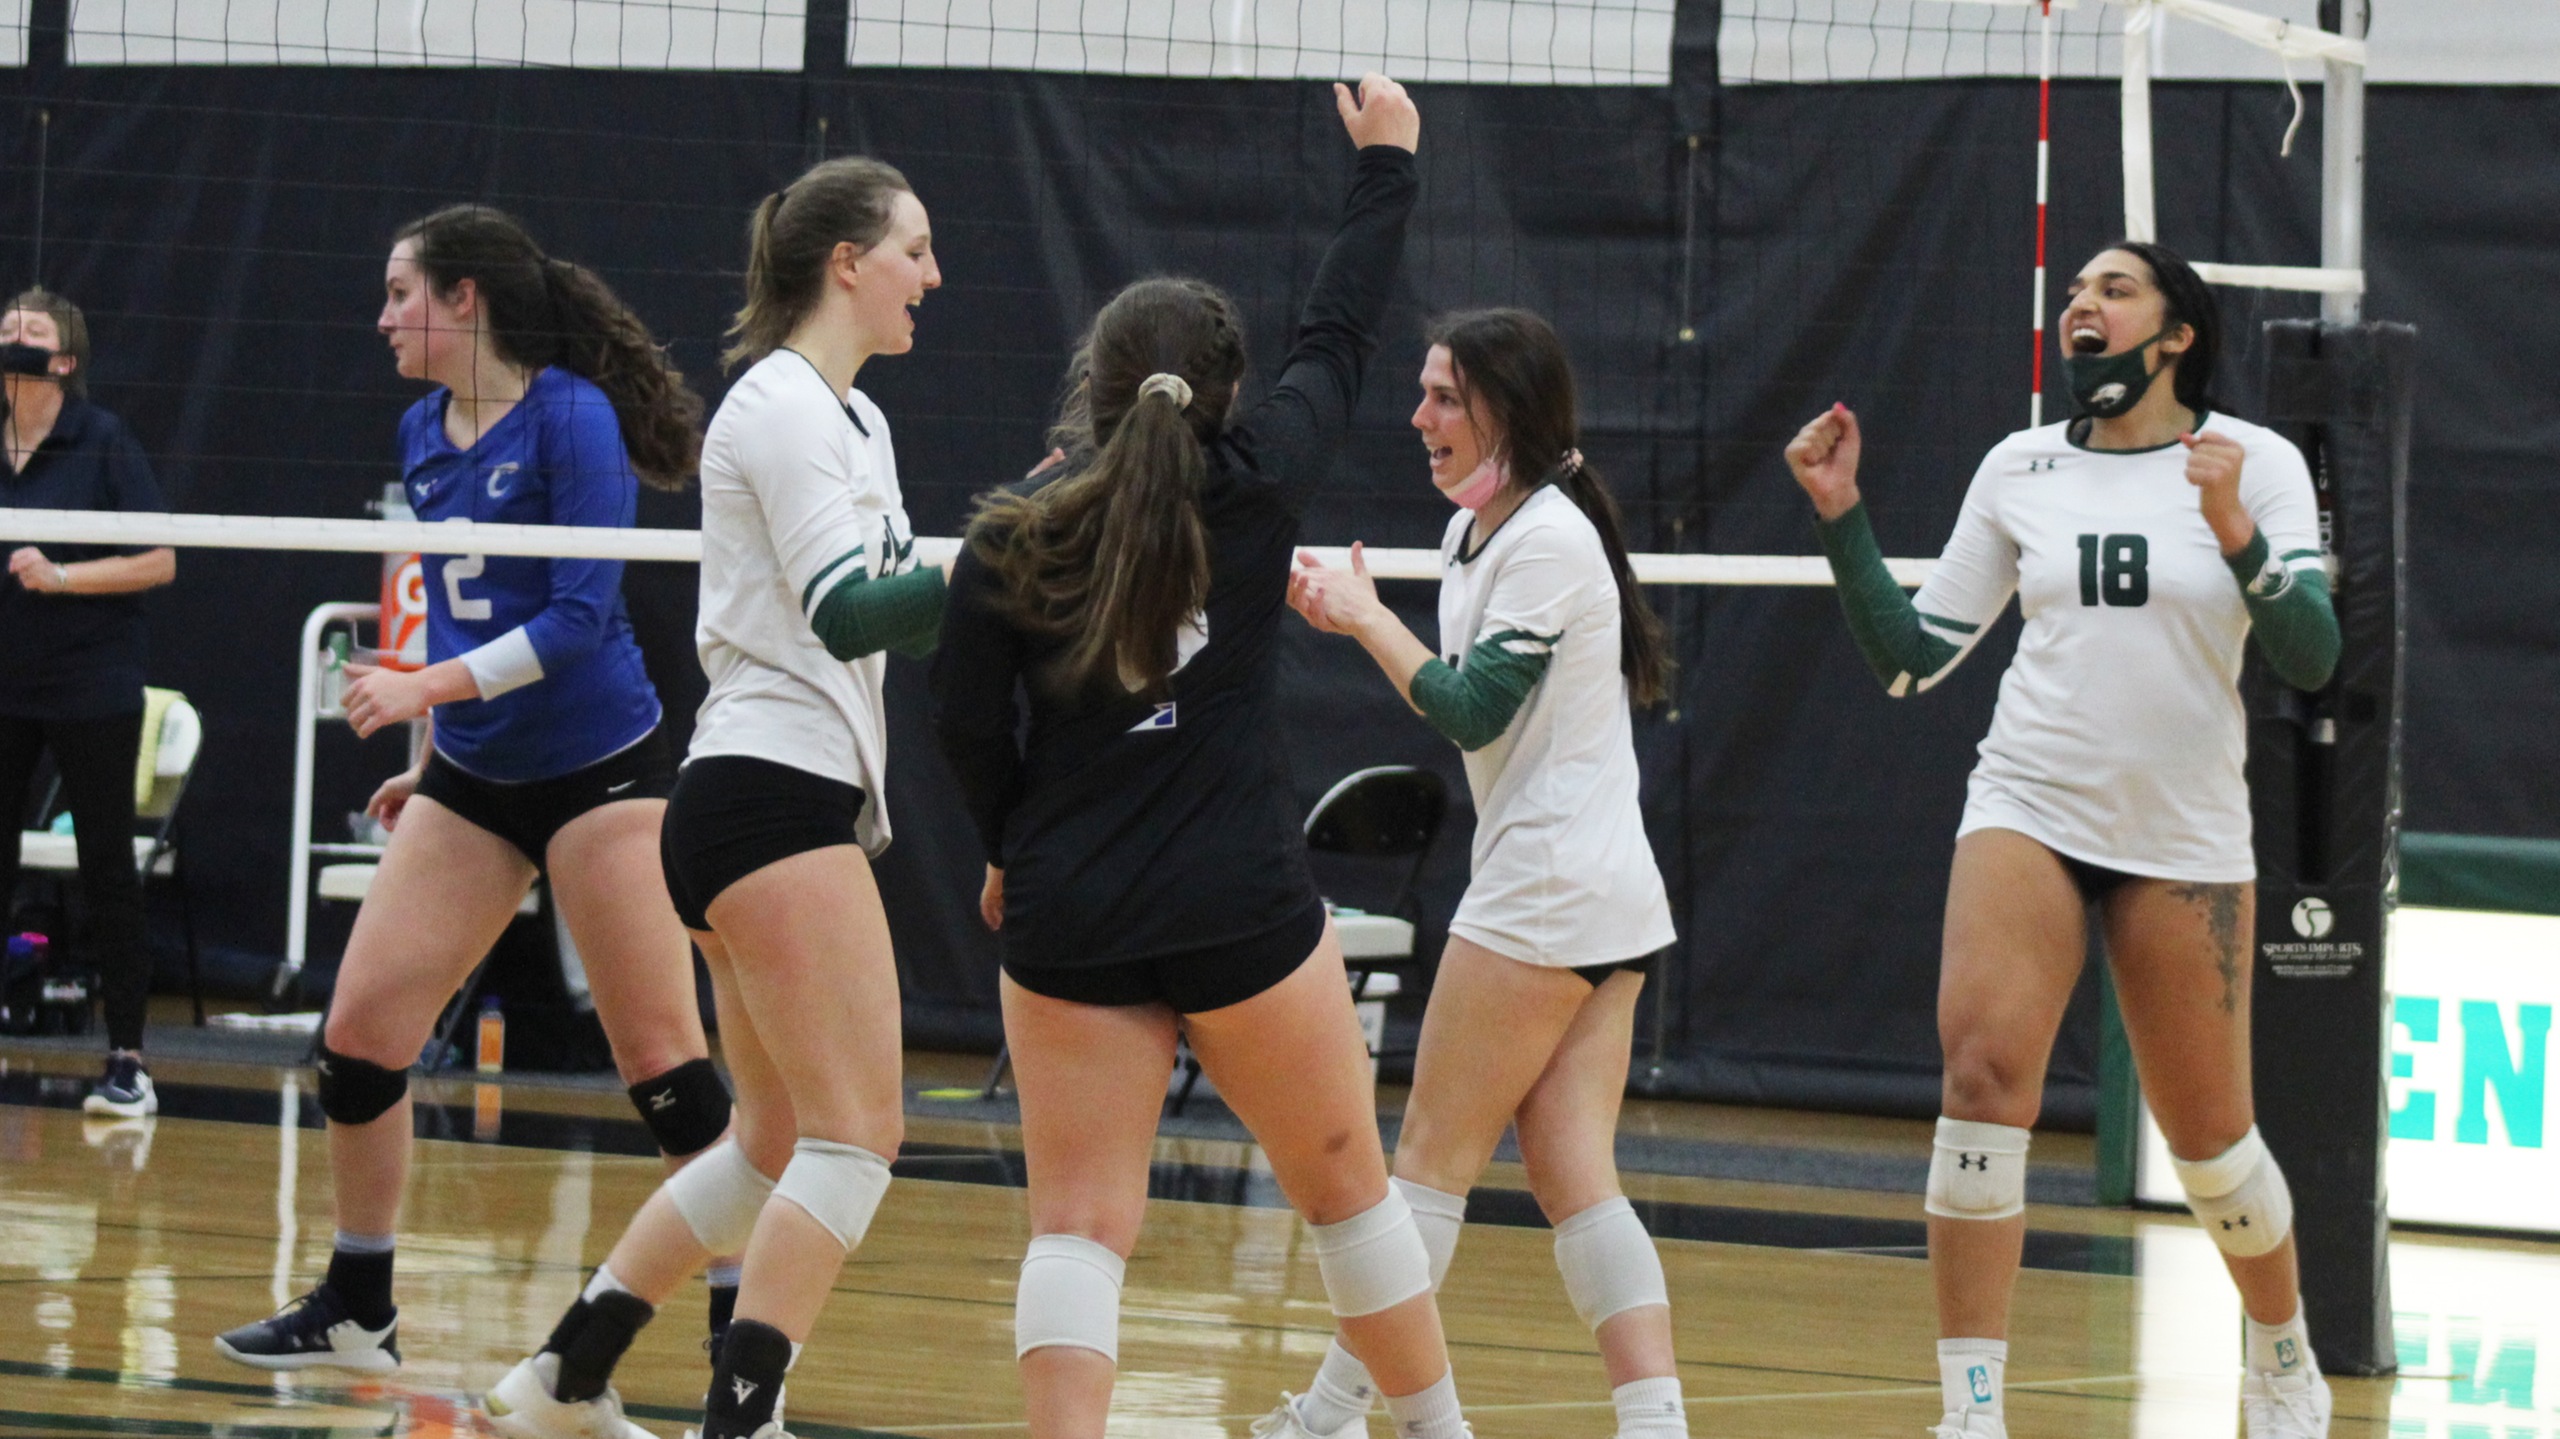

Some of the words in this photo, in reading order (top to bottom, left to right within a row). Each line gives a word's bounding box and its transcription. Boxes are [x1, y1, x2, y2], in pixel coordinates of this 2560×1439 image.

[397, 560, 428, 615] G
[442, 517, 492, 621] 2
[2077, 533, 2149, 607] 18
[2309, 943, 2363, 956] IMPRTS
